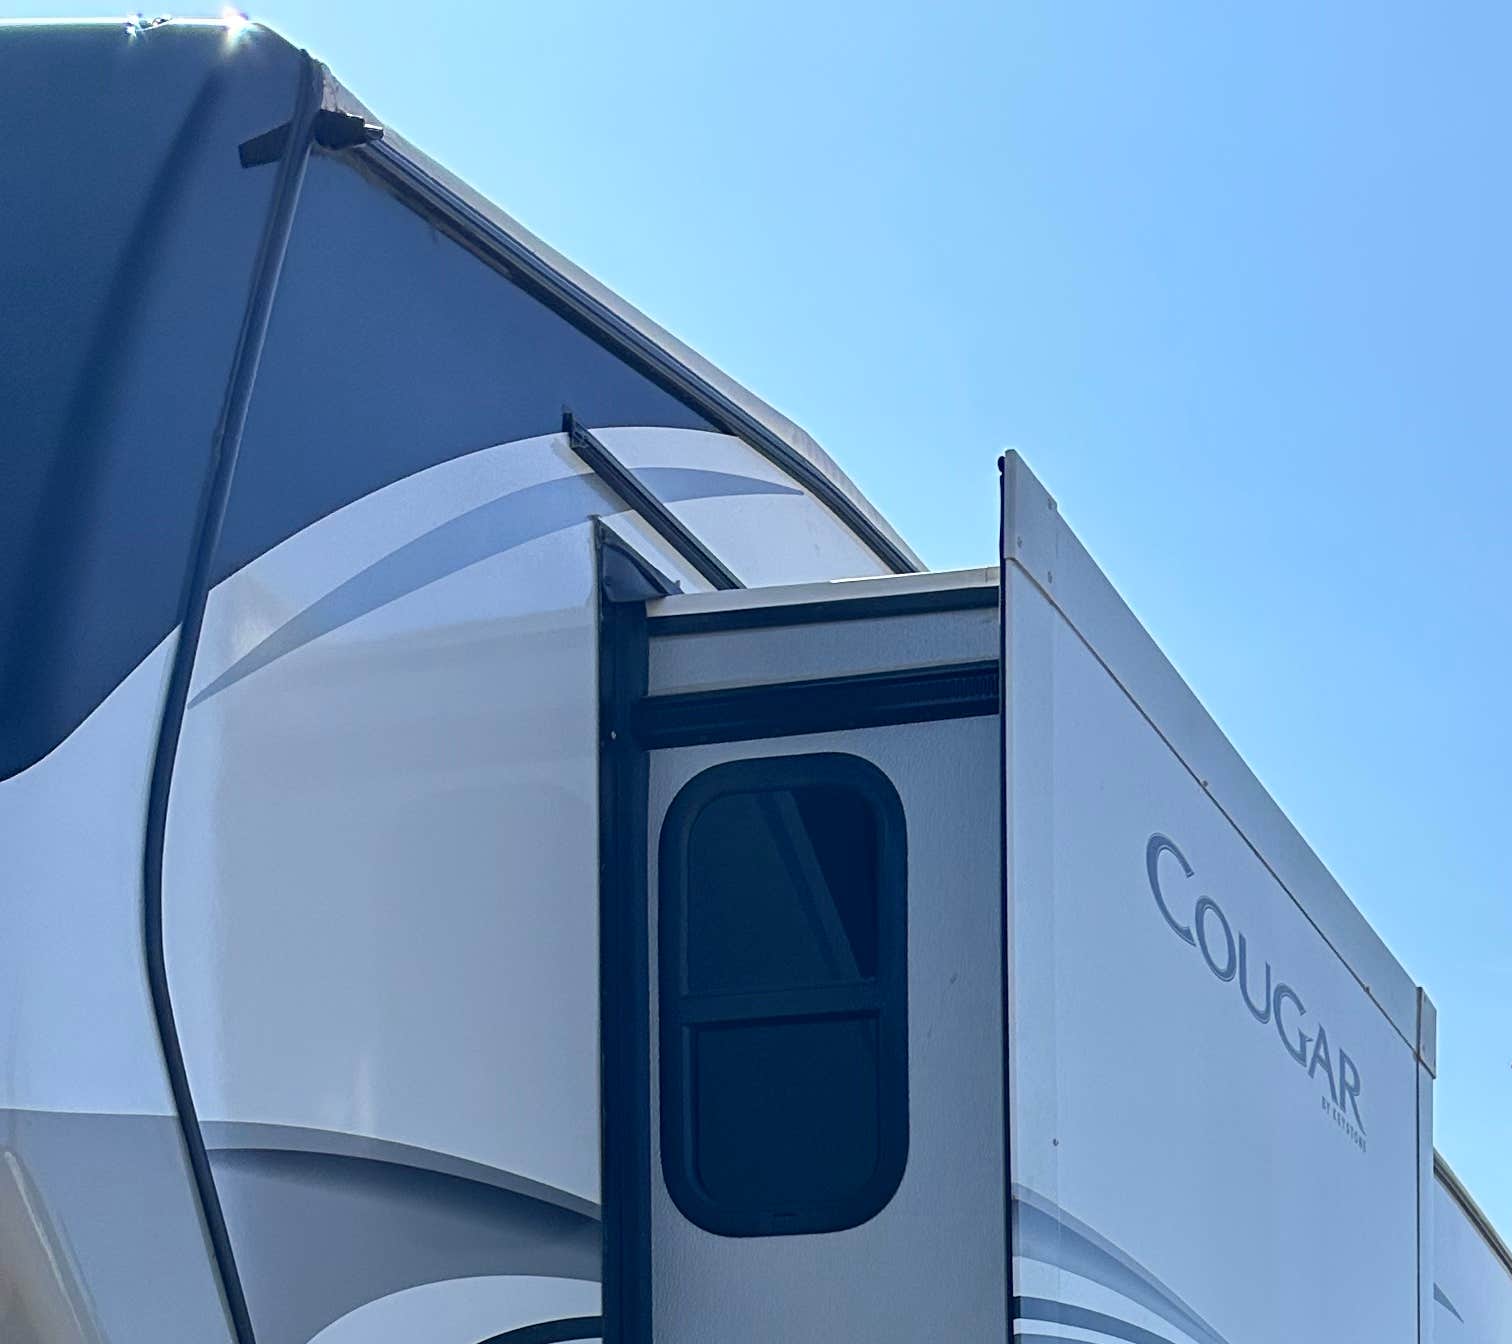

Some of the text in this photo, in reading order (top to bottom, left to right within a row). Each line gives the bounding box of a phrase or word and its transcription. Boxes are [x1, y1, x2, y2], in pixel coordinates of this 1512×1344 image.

[1146, 832, 1366, 1134] COUGAR
[1321, 1095, 1366, 1153] BY KEYSTONE
